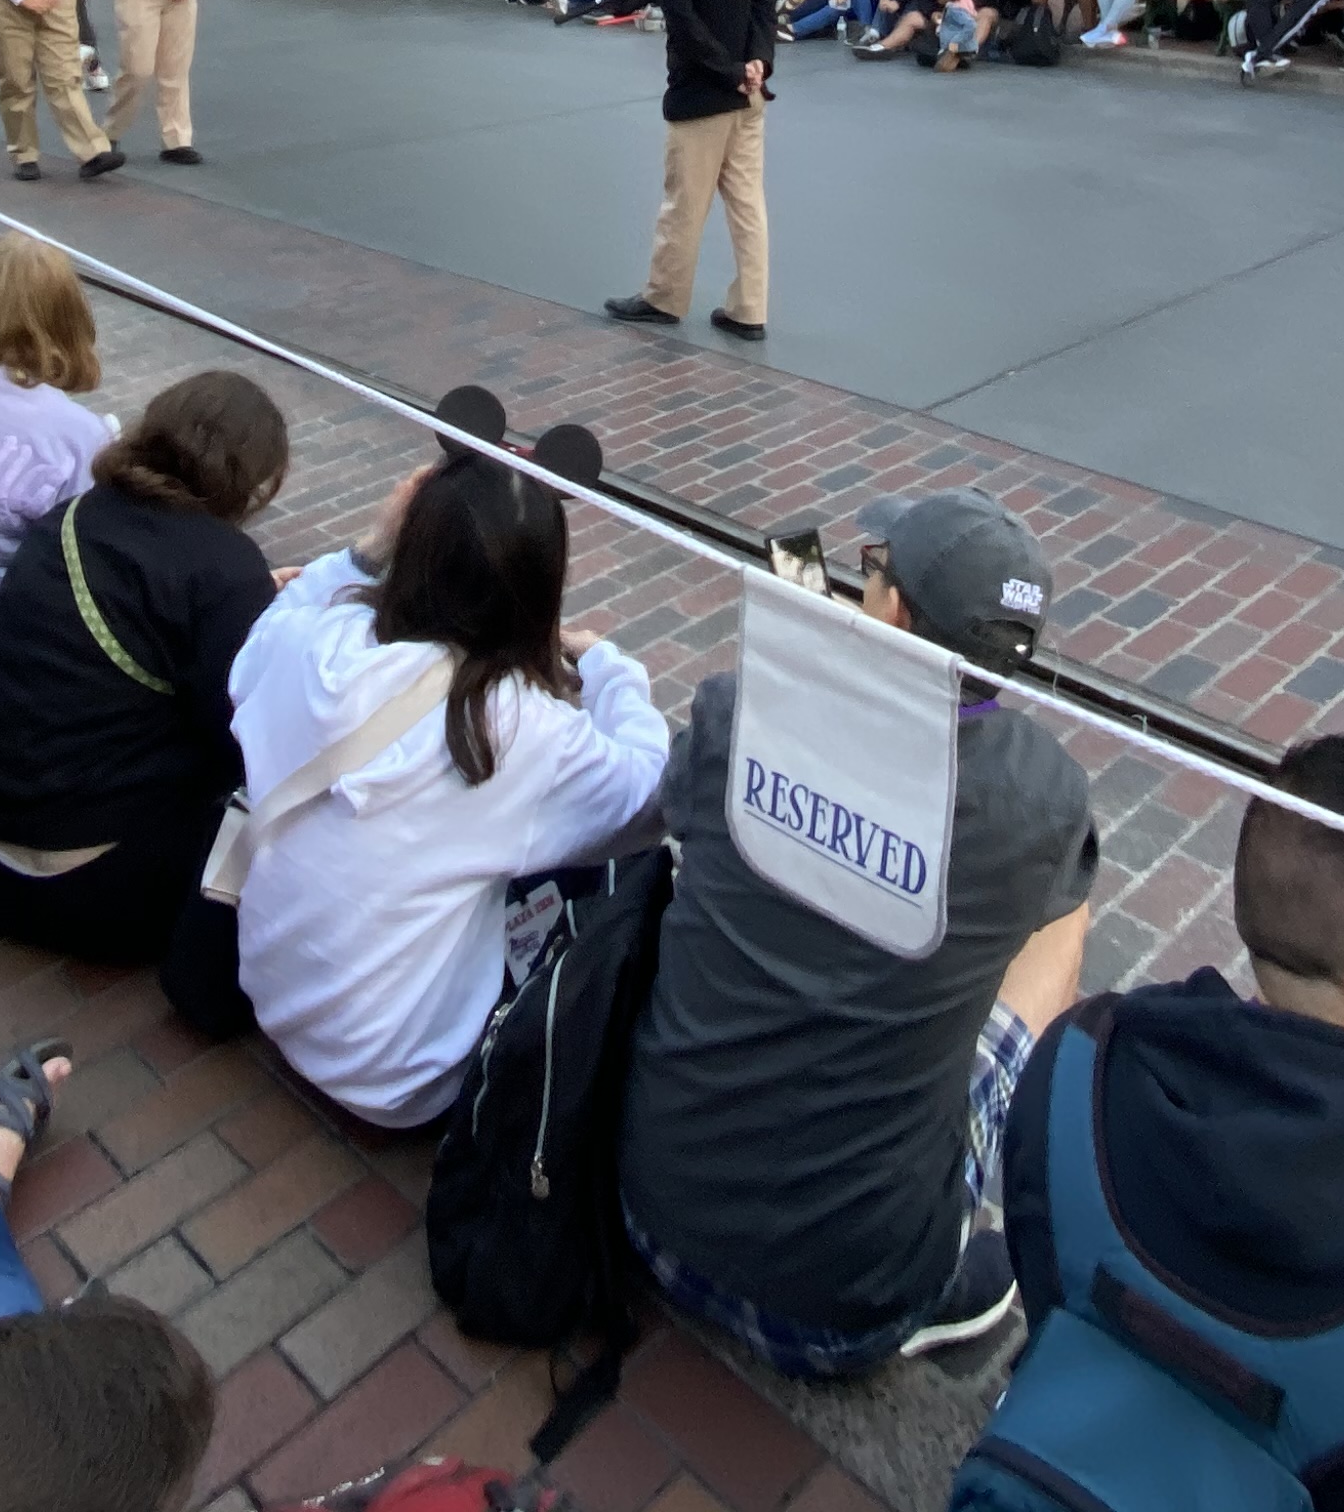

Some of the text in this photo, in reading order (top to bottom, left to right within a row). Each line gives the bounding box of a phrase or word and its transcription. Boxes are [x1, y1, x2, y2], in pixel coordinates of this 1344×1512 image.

[1003, 578, 1041, 595] STAR
[1003, 588, 1043, 607] WARS
[742, 756, 927, 896] RESERVED
[505, 909, 535, 932] LAZA
